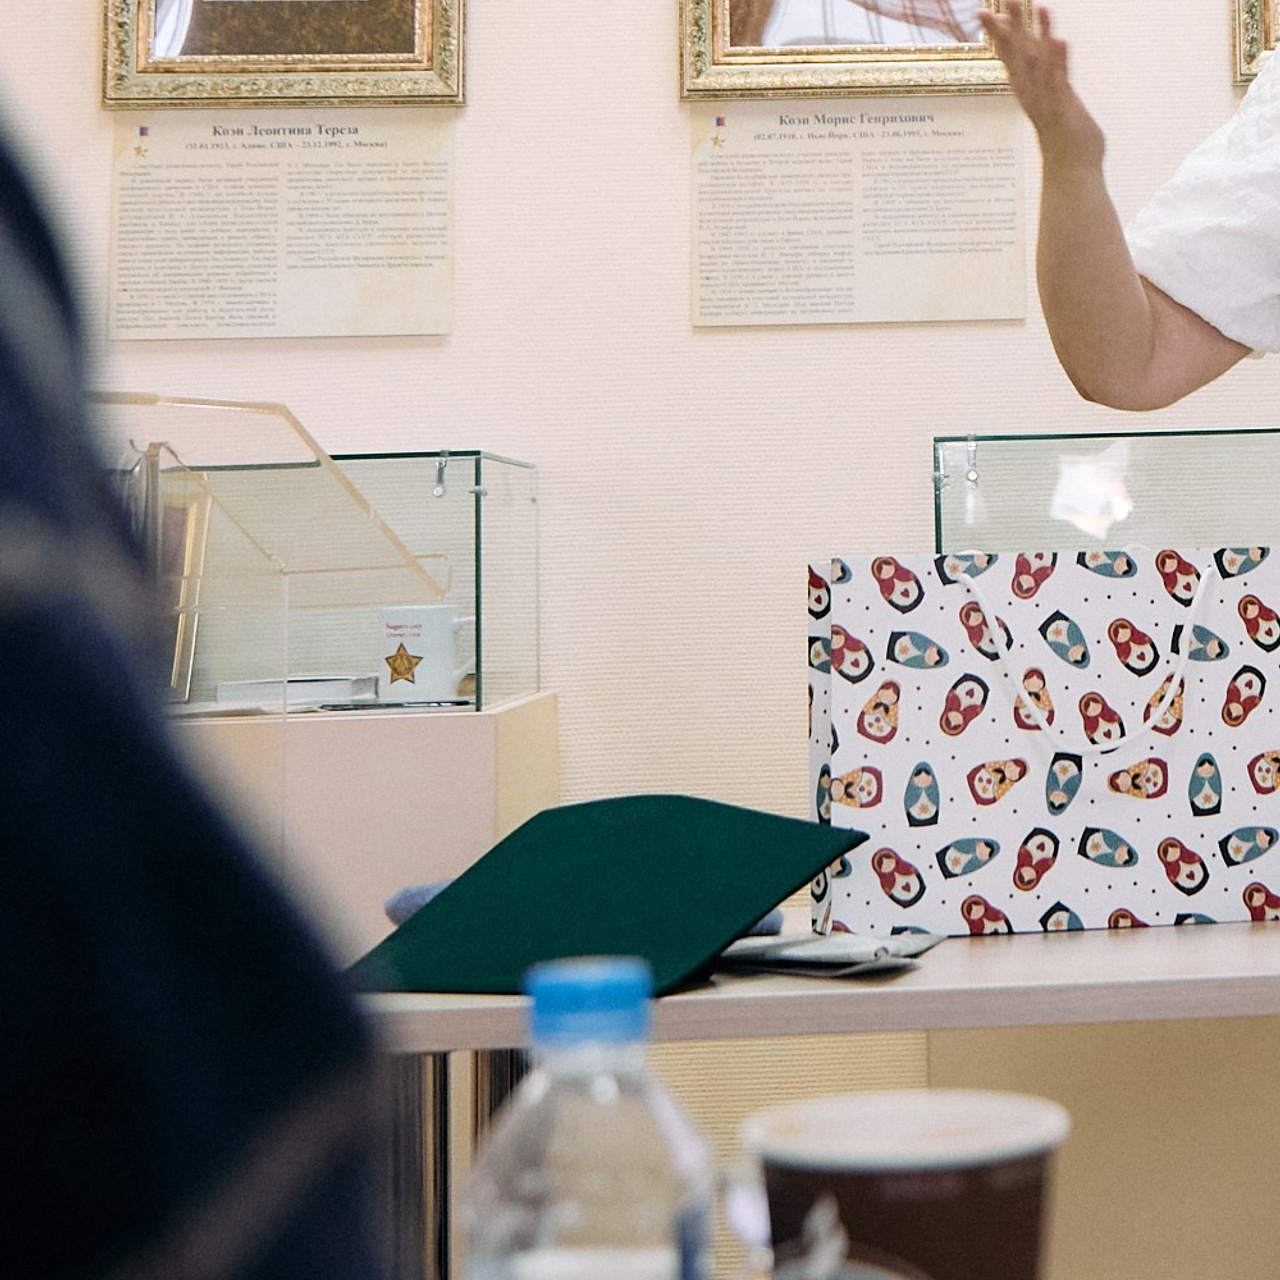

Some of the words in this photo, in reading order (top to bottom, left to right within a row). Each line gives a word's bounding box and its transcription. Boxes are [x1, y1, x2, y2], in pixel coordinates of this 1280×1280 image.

[779, 114, 809, 126] Коэн
[814, 113, 856, 127] Морис
[860, 112, 935, 126] Генрихович
[212, 125, 244, 136] Коэн
[248, 124, 312, 136] Леонтина
[316, 123, 359, 138] Тереза
